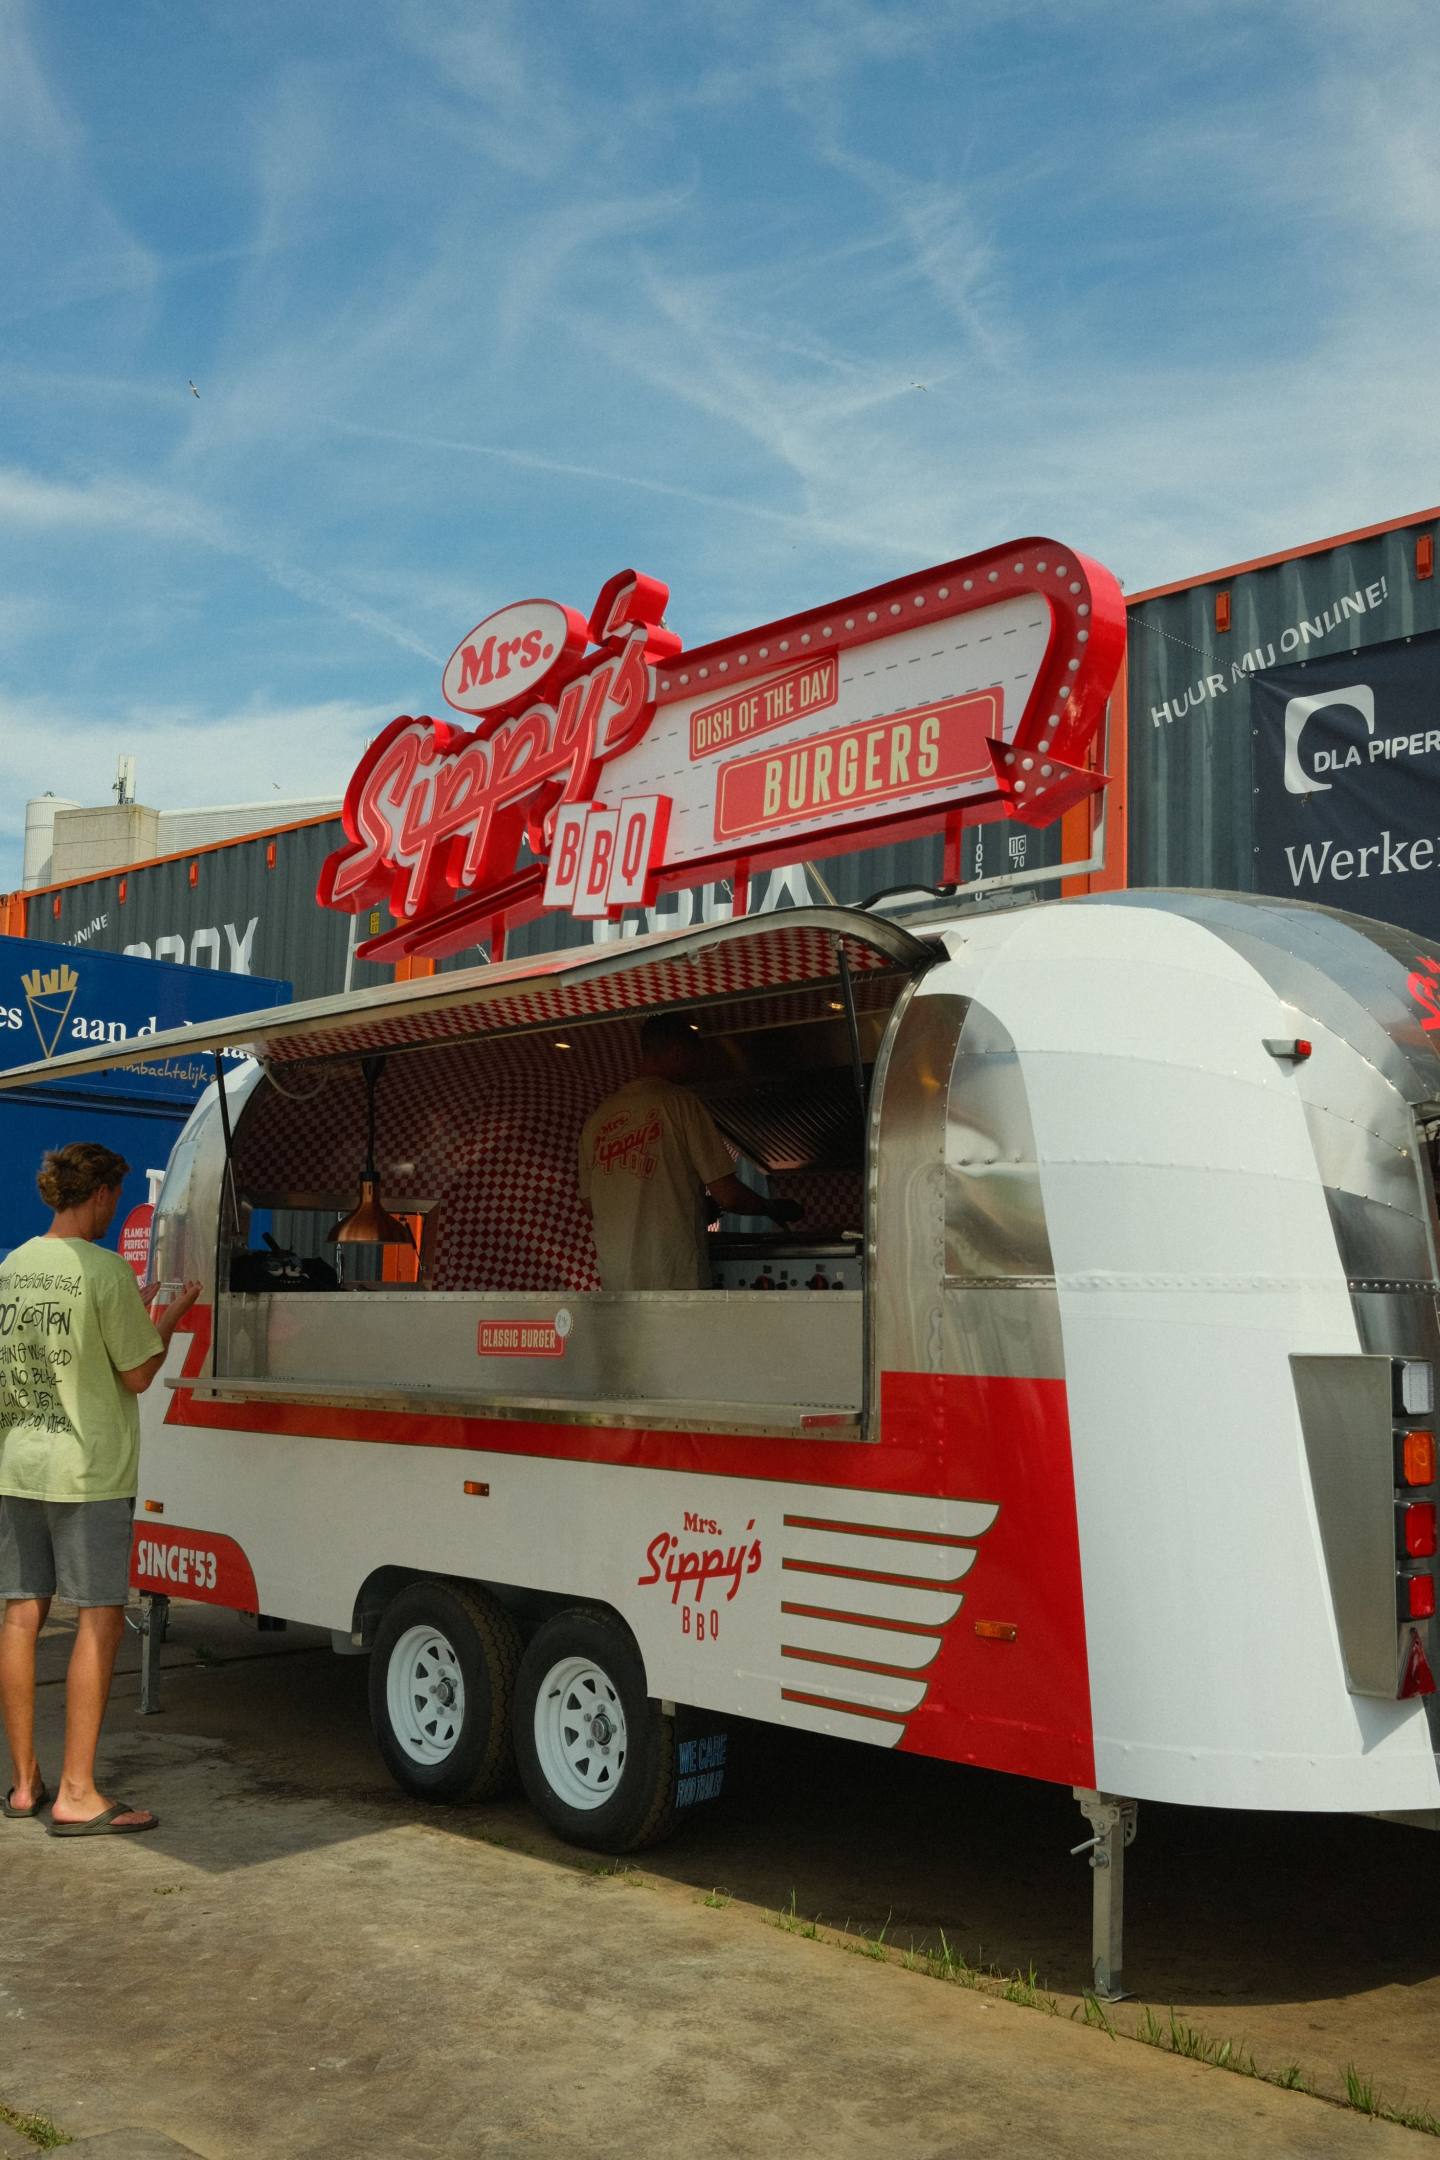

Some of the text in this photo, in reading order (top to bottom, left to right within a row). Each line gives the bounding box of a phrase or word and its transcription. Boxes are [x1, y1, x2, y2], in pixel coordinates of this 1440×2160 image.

[457, 630, 554, 694] Mrs.
[1150, 576, 1389, 728] HUUR MIJ ONLINE!
[696, 666, 832, 750] DISH OF THE DAY
[332, 586, 652, 908] Sippy's
[762, 717, 941, 817] BURGERS
[1313, 730, 1440, 773] DLA PIPER
[555, 812, 647, 896] BBQ
[1012, 856, 1025, 869] 70
[1284, 831, 1440, 887] Werke
[71, 1017, 127, 1043] aan
[482, 1329, 556, 1349] CLASSIC BURGER
[684, 1511, 722, 1535] Mrs.
[637, 1519, 762, 1605] Sippy's
[682, 1606, 719, 1641] BBQ
